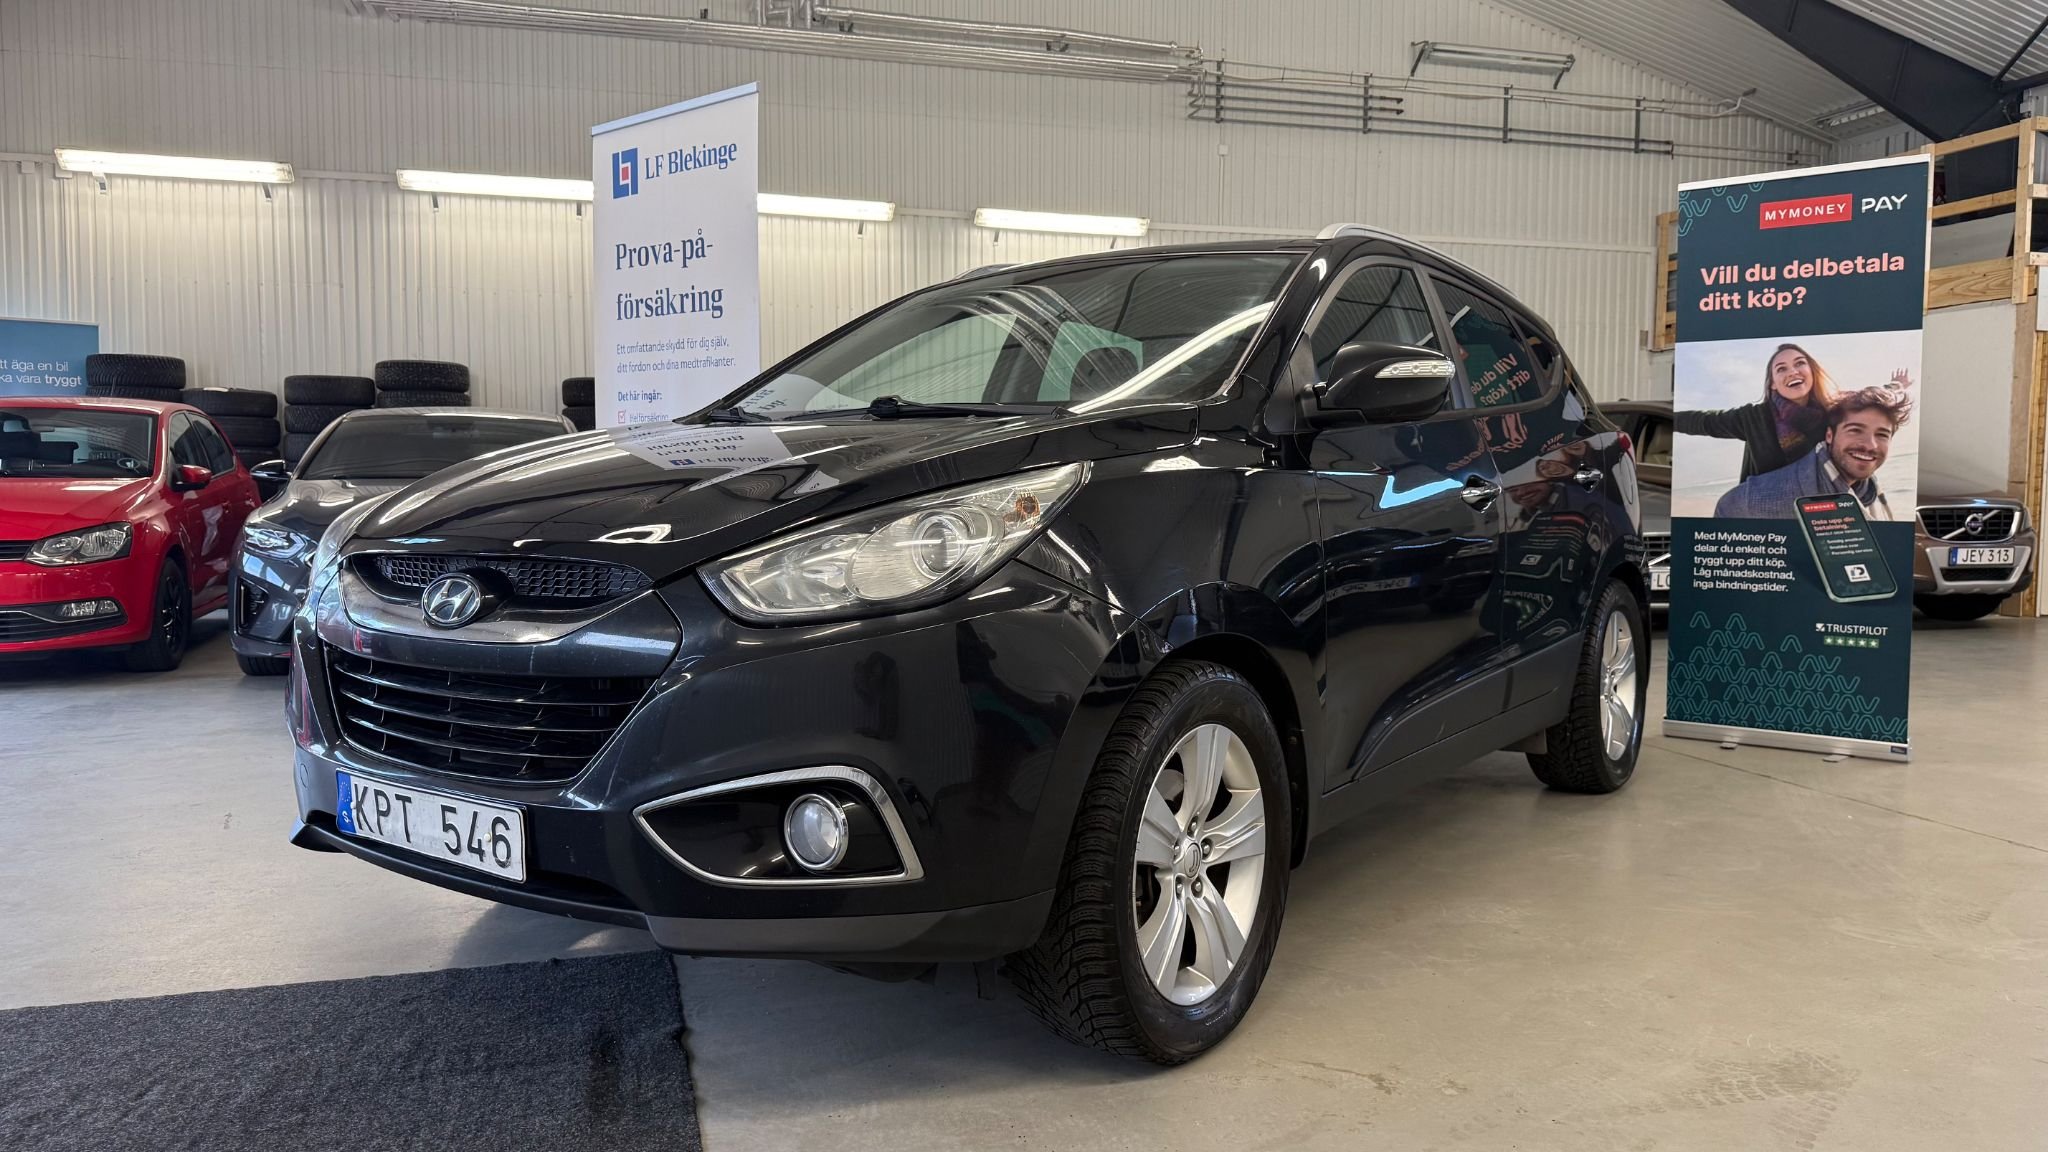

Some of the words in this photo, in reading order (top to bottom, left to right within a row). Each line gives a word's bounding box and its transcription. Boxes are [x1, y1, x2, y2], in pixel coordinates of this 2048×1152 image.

[645, 154, 664, 180] LF
[668, 143, 737, 174] Blekinge
[1765, 203, 1847, 222] MYMONEY
[1861, 193, 1908, 213] PAY
[616, 228, 713, 270] Prova-på-
[1700, 264, 1739, 286] Vill
[1745, 263, 1776, 282] du
[1783, 252, 1905, 279] delbetala
[616, 285, 724, 320] försäkring
[1699, 291, 1741, 312] ditt
[1747, 286, 1808, 311] köp?
[616, 343, 626, 355] Ett
[627, 341, 665, 353] omfattande
[665, 338, 685, 354] skydd
[687, 337, 697, 349] för
[699, 337, 709, 351] dig
[11, 359, 34, 372] äga
[37, 361, 52, 371] en
[55, 361, 69, 372] bil
[629, 361, 651, 372] fordon
[652, 360, 665, 371] och
[16, 374, 41, 384] vara
[45, 374, 82, 387] tryggt
[618, 391, 628, 402] Det
[629, 389, 640, 401] här
[1694, 531, 1716, 540] Med
[1718, 531, 1766, 543] MyMoney
[1768, 533, 1787, 544] Pay
[1694, 544, 1719, 552] delar
[1720, 544, 1734, 553] du
[1735, 545, 1766, 554] enkelt
[1767, 546, 1787, 555] och
[1962, 549, 1985, 563] JEY
[1987, 549, 2010, 563] 313
[1694, 556, 1724, 567] tryggt
[1725, 557, 1745, 567] upp
[1746, 556, 1764, 566] ditt
[1765, 557, 1787, 569] köp.
[1693, 567, 1712, 578] Låg
[1713, 568, 1796, 580] månadskostnad,
[1693, 579, 1714, 590] inga
[1715, 580, 1789, 592] bindningstider.
[1826, 623, 1889, 636] TRUSTPILOT
[354, 783, 412, 844] KPT
[440, 804, 512, 869] 546
